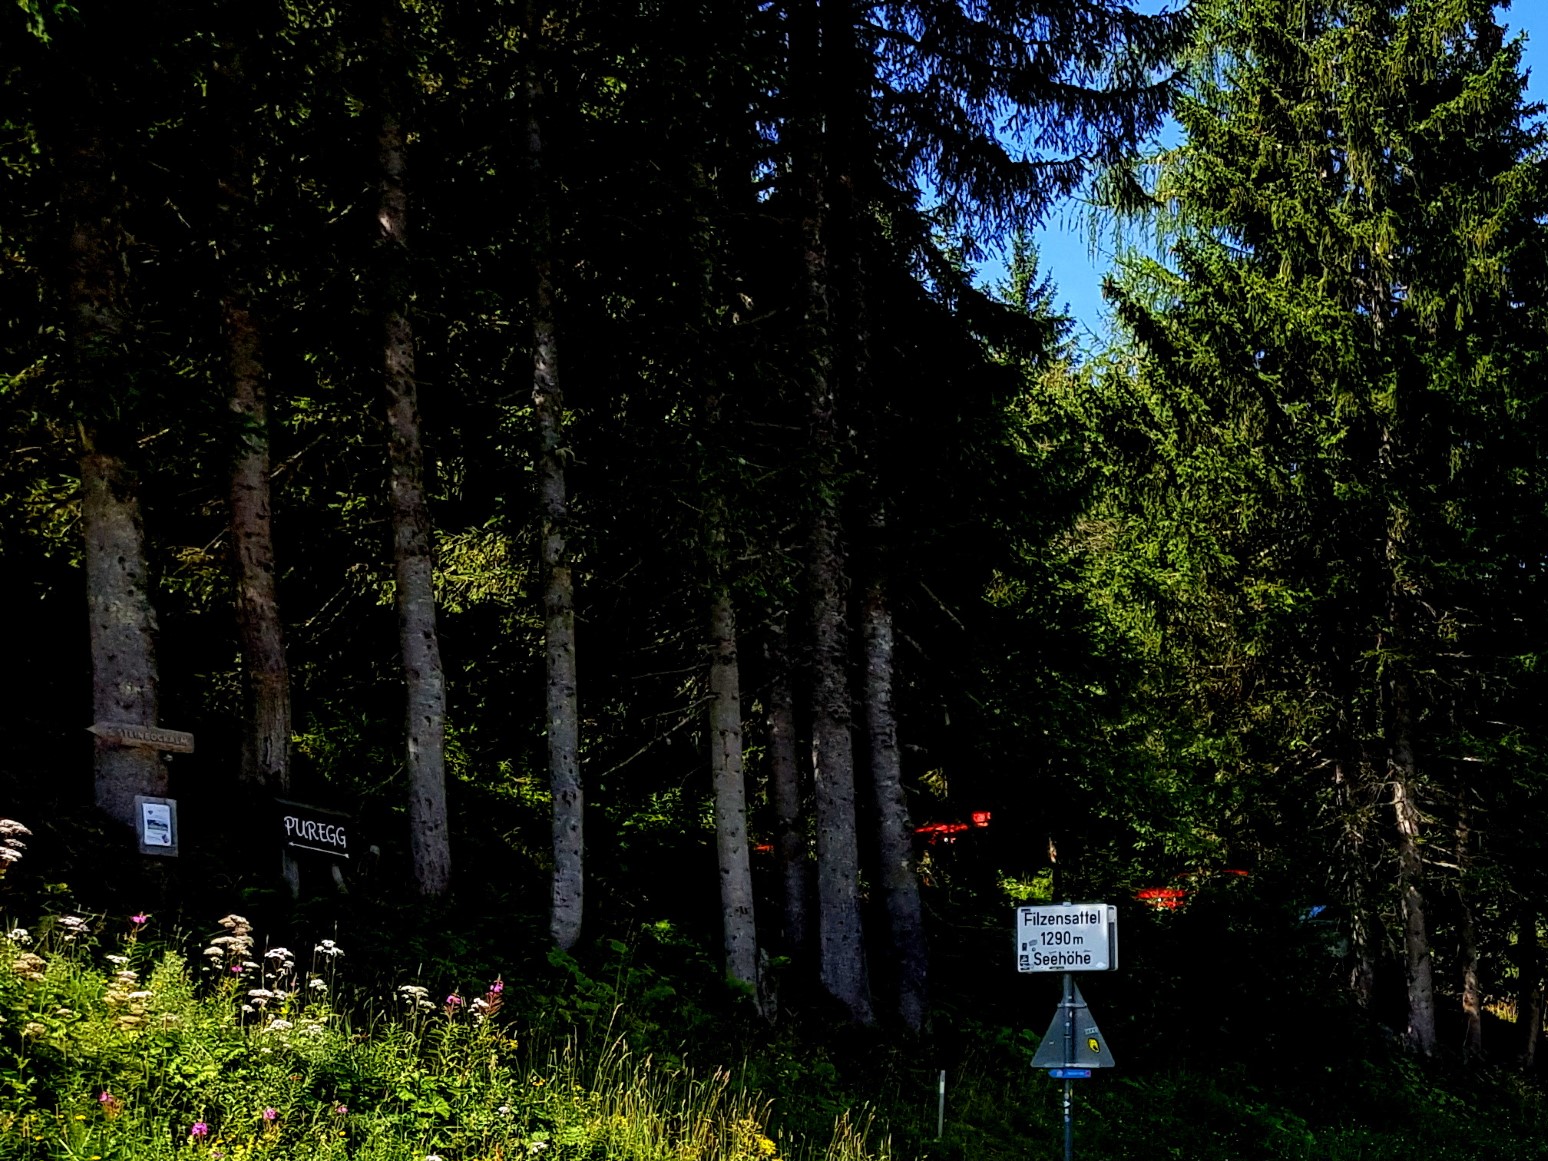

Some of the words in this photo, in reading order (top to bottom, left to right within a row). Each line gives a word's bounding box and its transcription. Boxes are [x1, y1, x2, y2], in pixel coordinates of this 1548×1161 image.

[283, 815, 347, 849] PUREGG
[1024, 909, 1101, 927] Filzensattel
[1040, 930, 1071, 946] 1290
[1072, 935, 1084, 945] m
[1033, 950, 1091, 966] Seehöhe
